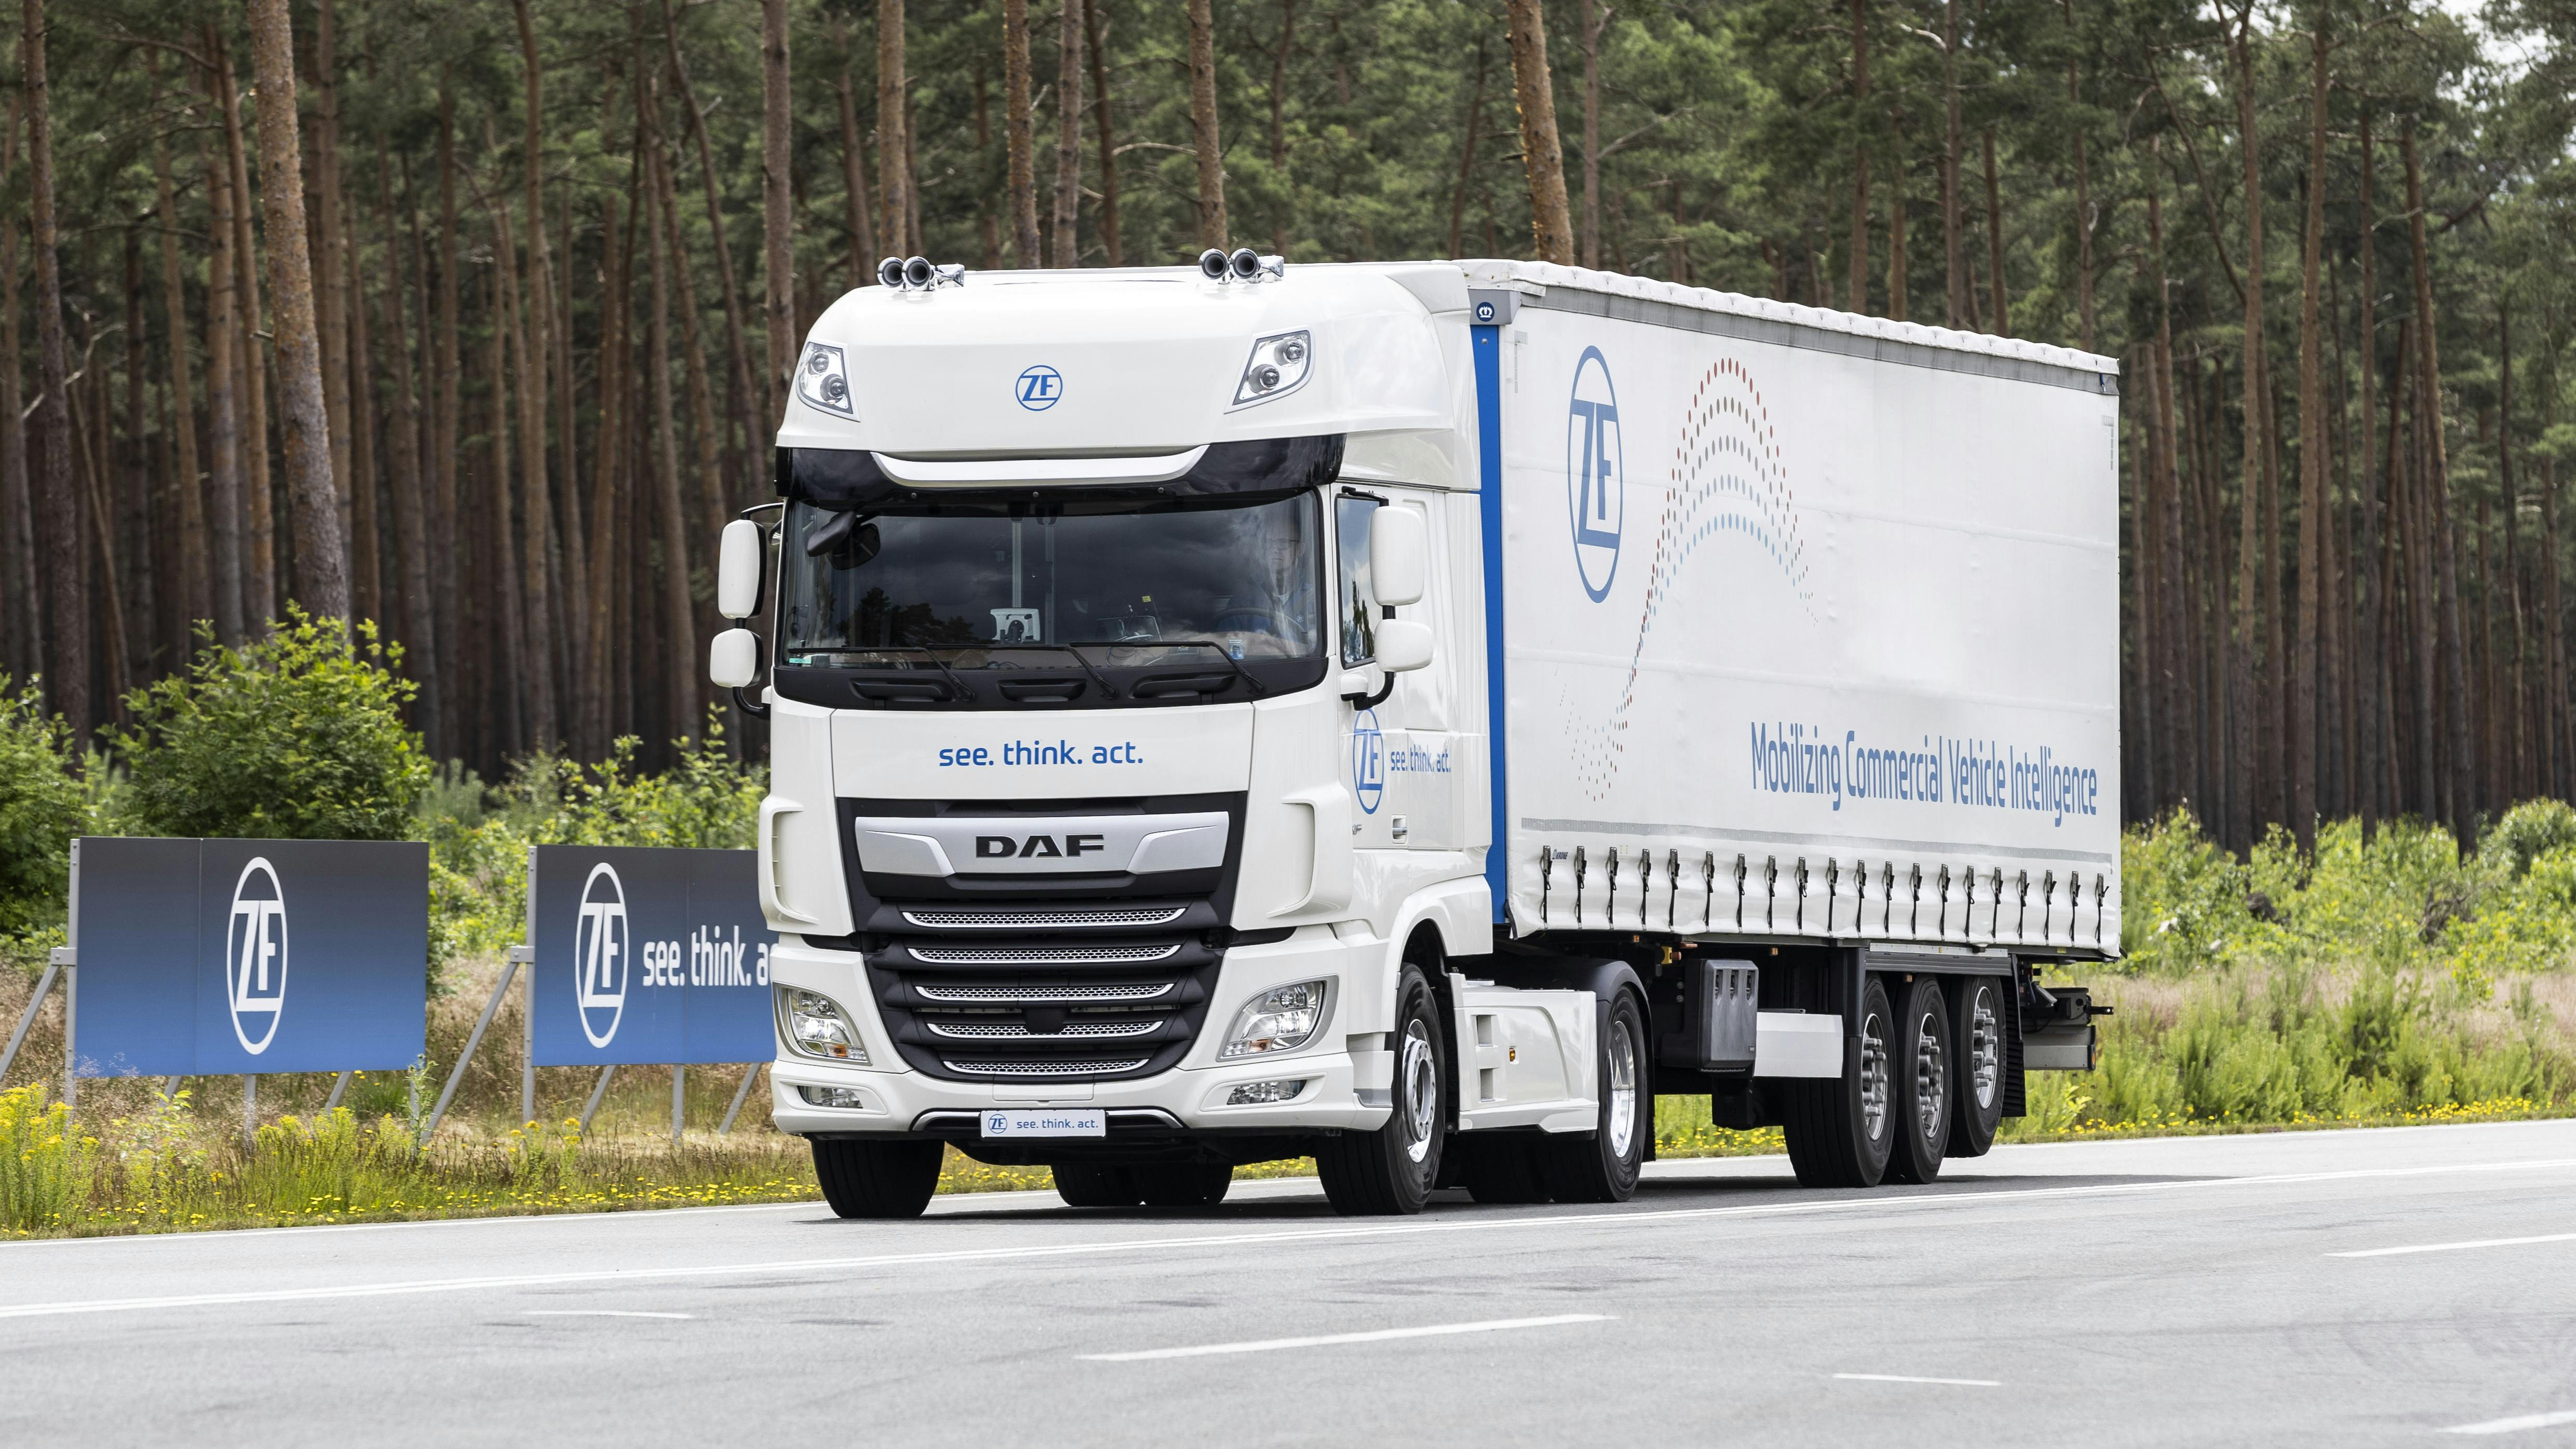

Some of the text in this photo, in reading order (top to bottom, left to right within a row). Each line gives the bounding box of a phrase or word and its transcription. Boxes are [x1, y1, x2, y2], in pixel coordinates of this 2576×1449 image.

[939, 740, 1143, 766] see. think. act.
[1391, 743, 1451, 772] see. think. act.
[1751, 722, 2097, 828] Mobilizing Commercial Vehicle Intelligence
[976, 833, 1104, 859] DAF
[643, 941, 685, 986] see.
[691, 925, 751, 986] think.
[1042, 1119, 1074, 1128] think.
[1077, 1119, 1098, 1128] act.
